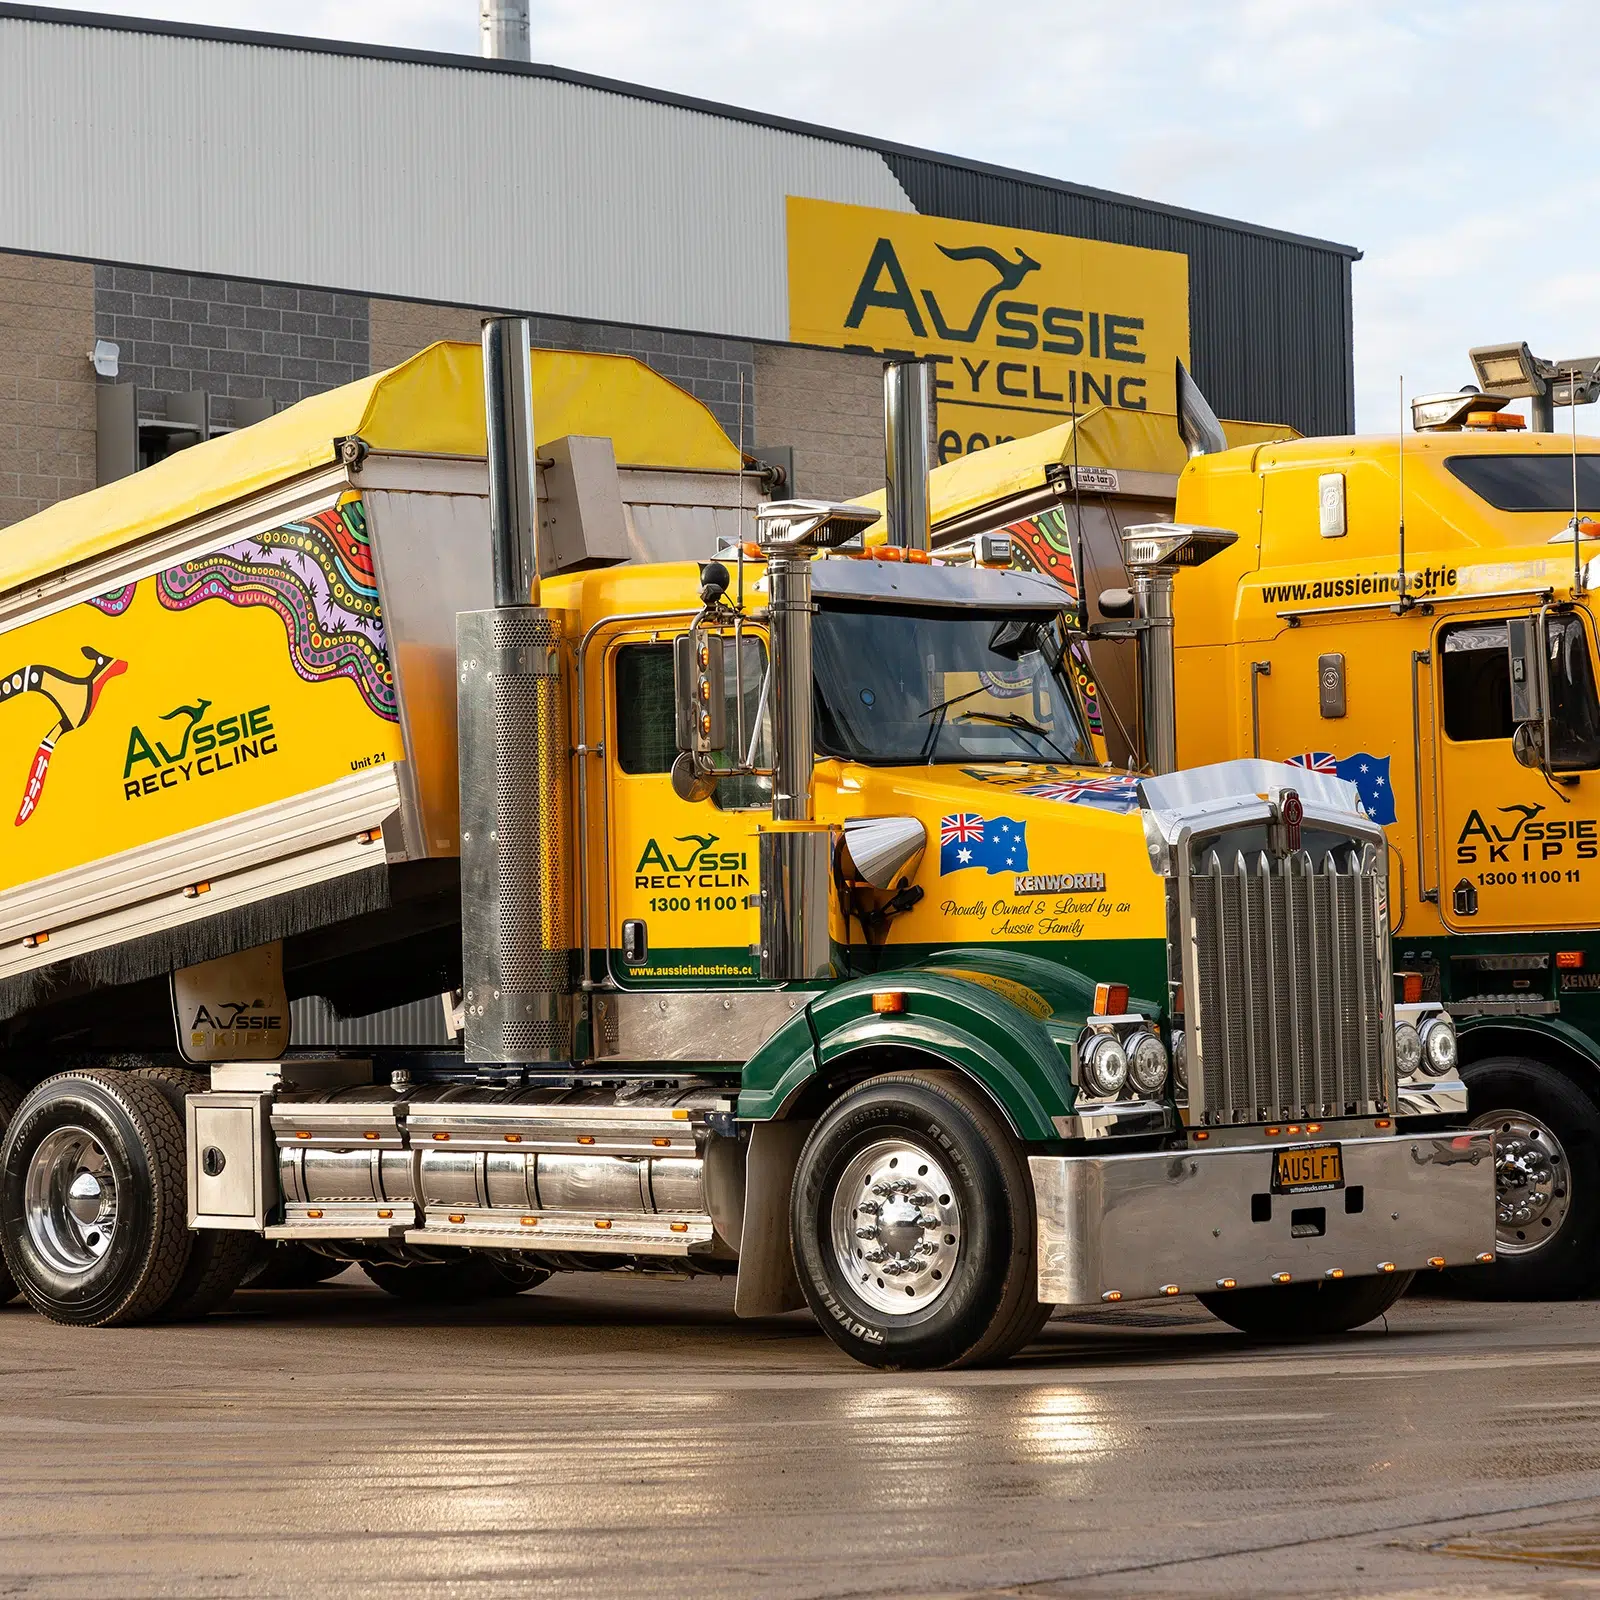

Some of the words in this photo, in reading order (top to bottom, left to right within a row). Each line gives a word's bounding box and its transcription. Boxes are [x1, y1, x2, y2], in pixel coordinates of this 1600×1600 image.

[843, 237, 1146, 364] AUSSIE
[123, 698, 274, 779] AUSSIE
[123, 734, 278, 800] RECYCLING
[350, 756, 371, 771] Unit
[373, 751, 386, 764] 21
[1457, 802, 1598, 844] AUSSIE
[1457, 840, 1598, 864] SKIPS
[1014, 872, 1105, 892] KENWORTH
[1477, 872, 1517, 886] 1300
[1565, 869, 1580, 883] 11
[649, 897, 691, 912] 1300
[940, 900, 987, 920] Proudly
[991, 899, 1034, 916] Owned
[1034, 901, 1046, 915] &
[1053, 897, 1096, 914] Loved
[1097, 898, 1112, 917] by
[1116, 902, 1131, 913] an
[991, 919, 1034, 935] Aussie
[1038, 918, 1085, 938] Family
[191, 1001, 282, 1030] AUSSIE
[1282, 1156, 1338, 1181] AUSLFT
